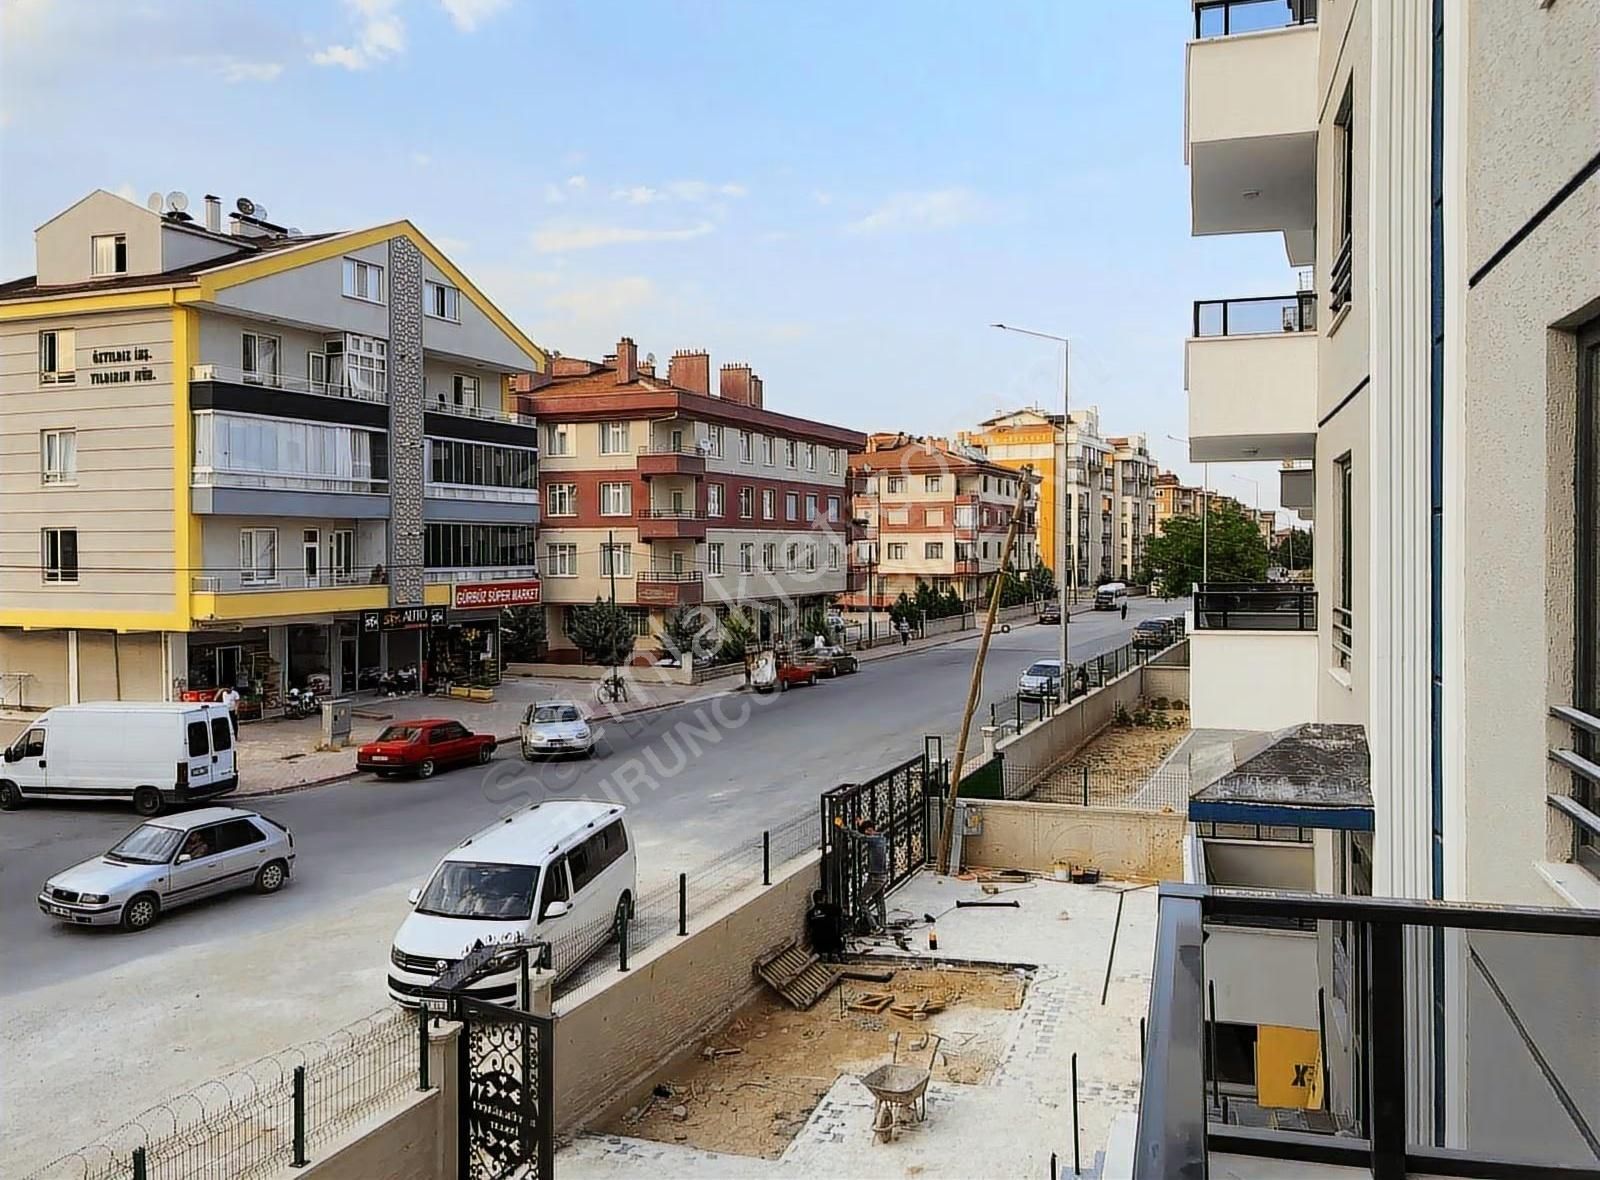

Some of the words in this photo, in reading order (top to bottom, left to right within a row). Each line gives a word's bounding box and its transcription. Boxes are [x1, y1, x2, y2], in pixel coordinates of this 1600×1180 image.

[488, 587, 511, 602] SÜPER
[512, 587, 538, 600] MARKET
[402, 609, 428, 622] AUTO
